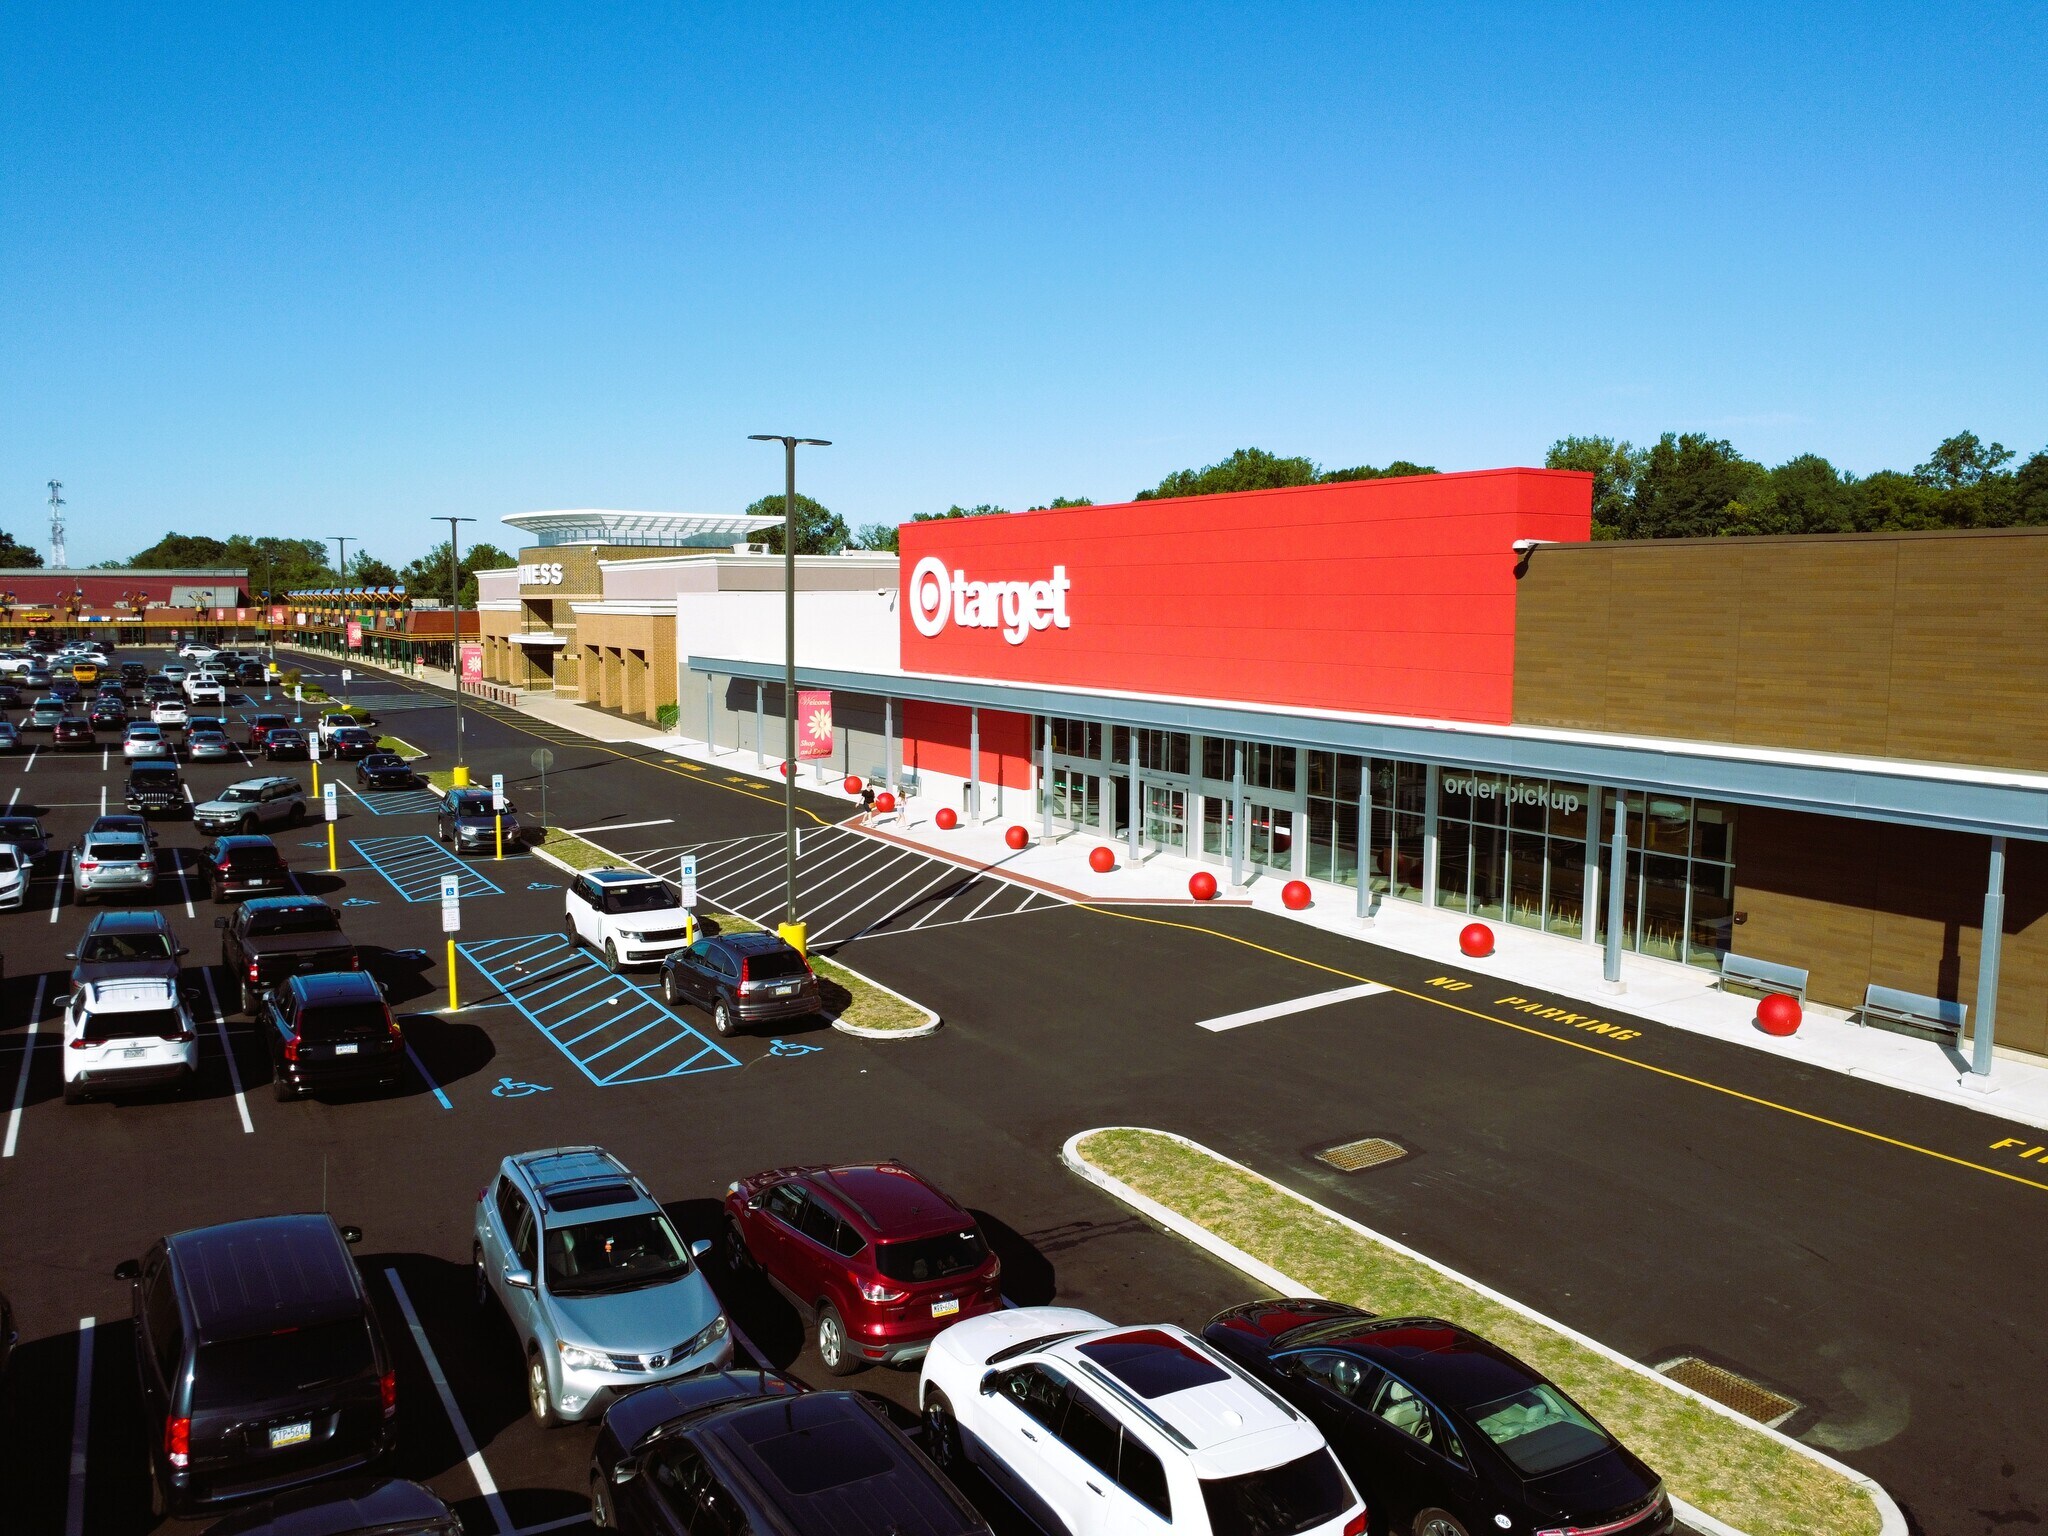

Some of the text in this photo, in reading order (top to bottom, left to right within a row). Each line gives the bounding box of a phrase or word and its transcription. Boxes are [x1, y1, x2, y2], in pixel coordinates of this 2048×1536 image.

[951, 565, 1070, 645] target
[1445, 776, 1579, 816] order pickup
[1424, 976, 1642, 1041] NO PARKING
